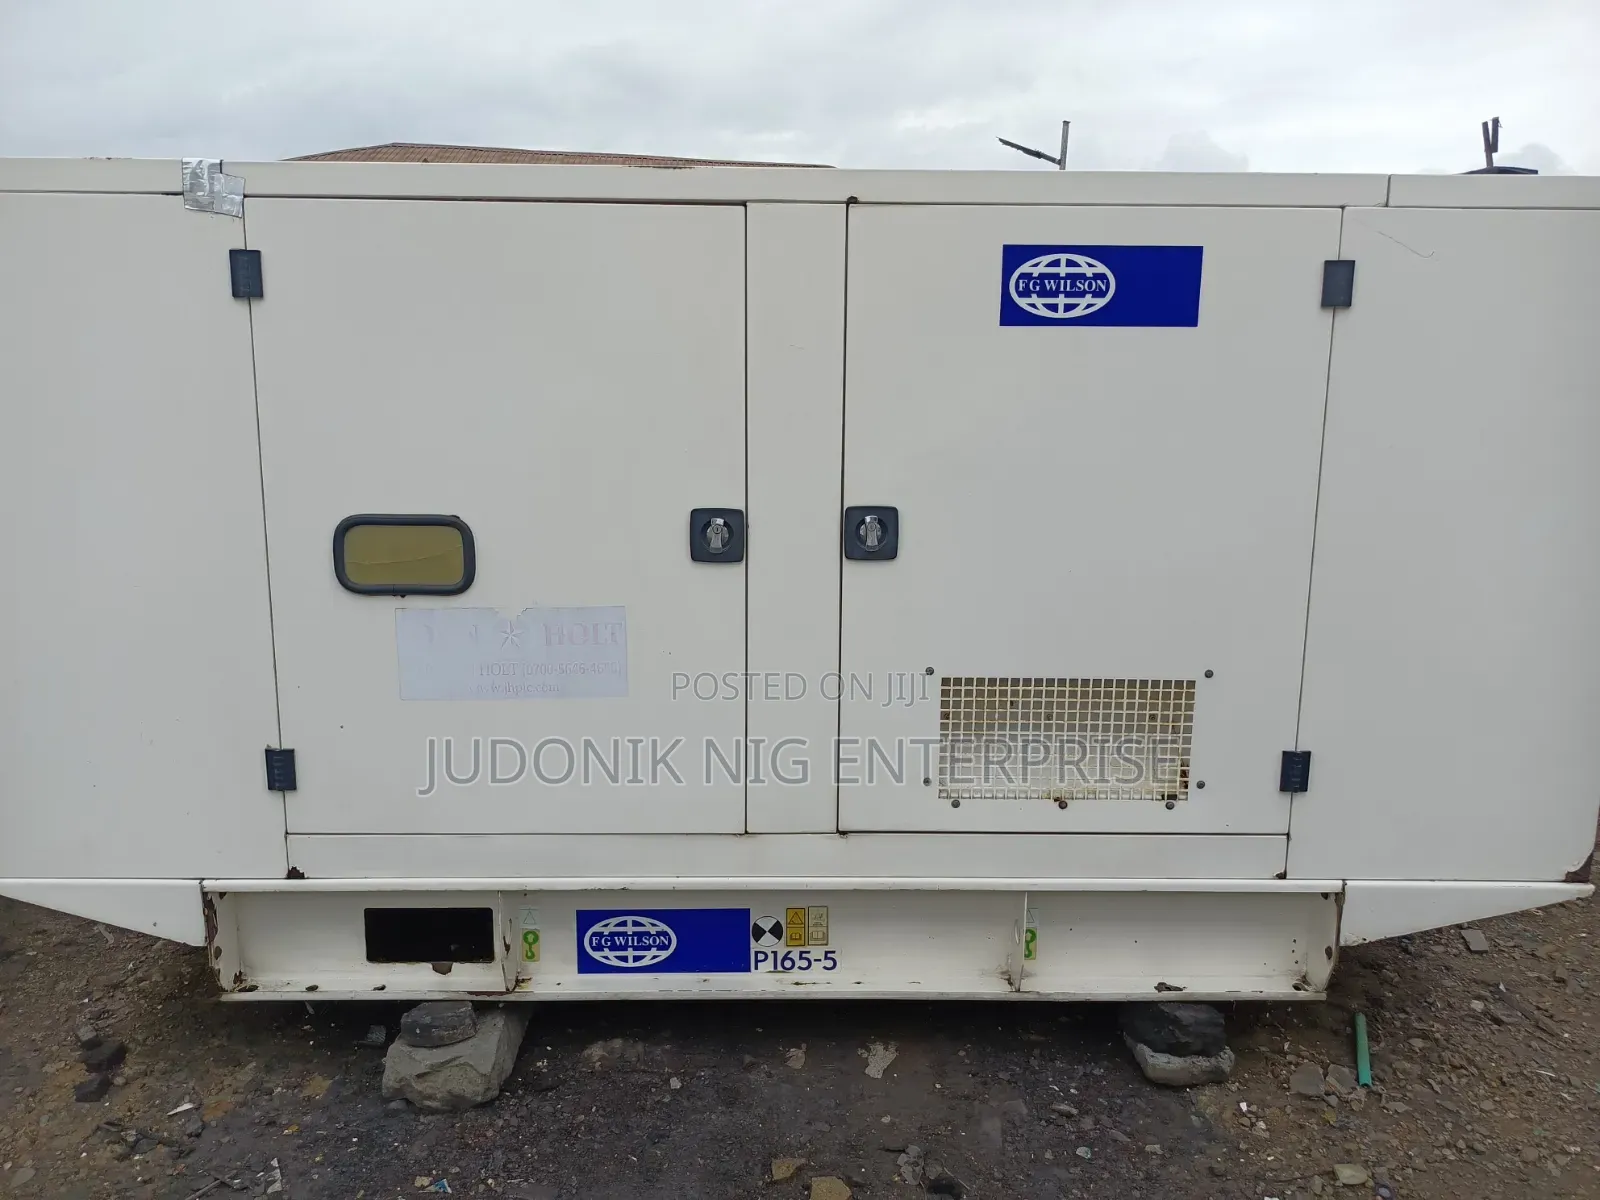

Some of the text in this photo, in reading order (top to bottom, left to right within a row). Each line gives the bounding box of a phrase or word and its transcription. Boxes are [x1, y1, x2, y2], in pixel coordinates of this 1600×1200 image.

[1044, 279, 1107, 292] WILSON
[543, 620, 623, 646] HOLT
[614, 935, 669, 947] WILSON
[754, 950, 838, 971] P165-5
